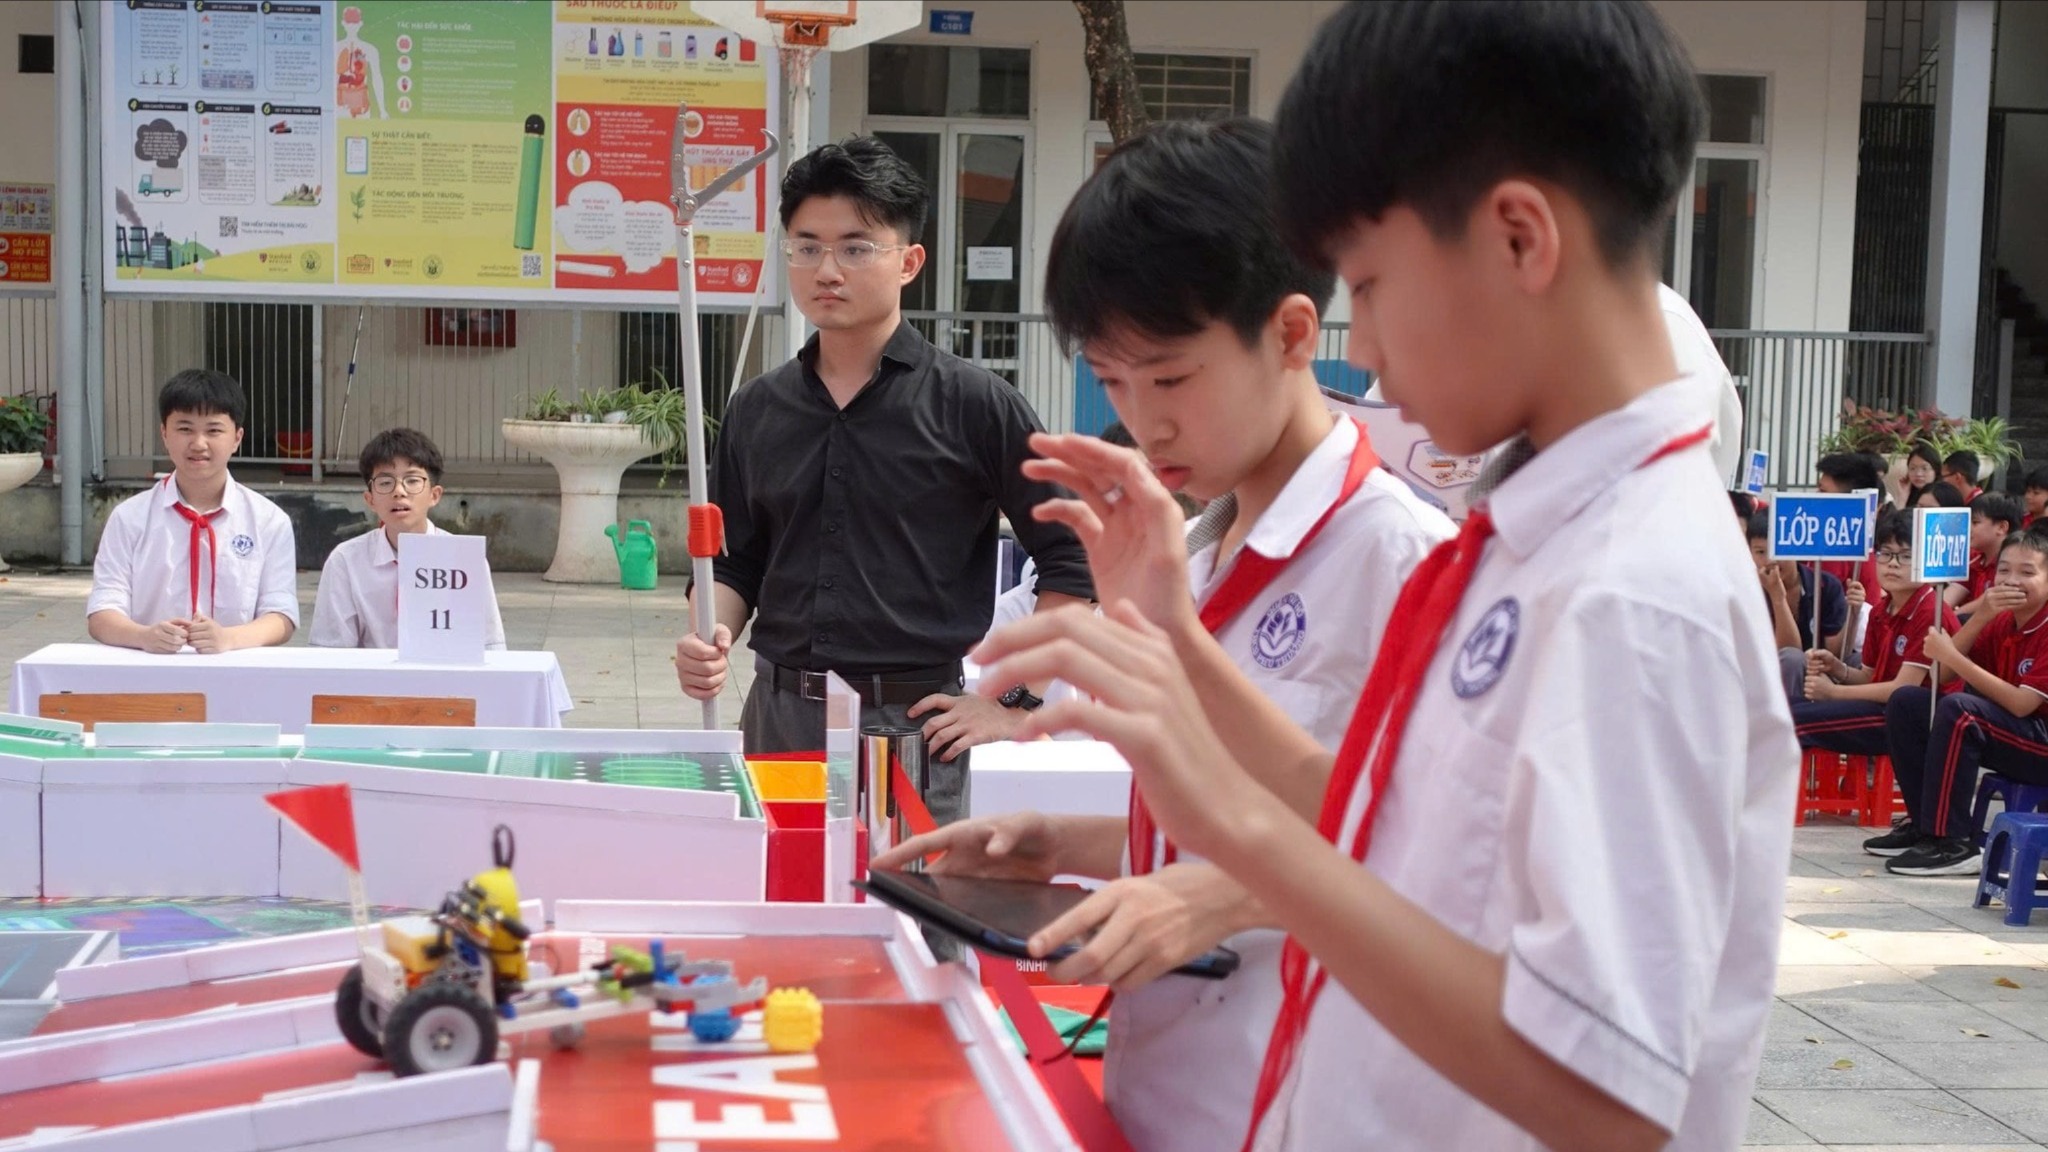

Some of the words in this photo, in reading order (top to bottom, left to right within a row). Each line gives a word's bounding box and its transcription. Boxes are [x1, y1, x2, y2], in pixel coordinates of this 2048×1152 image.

[196, 2, 204, 12] 2
[263, 3, 271, 13] 3
[197, 102, 204, 112] 5
[264, 103, 271, 115] 6
[13, 248, 25, 256] NO
[1777, 506, 1820, 546] LỚP
[1823, 516, 1864, 546] 6A7
[1926, 523, 1946, 567] LỚP
[1948, 534, 1966, 567] 7A7
[414, 567, 468, 590] SBD
[430, 608, 452, 630] 11
